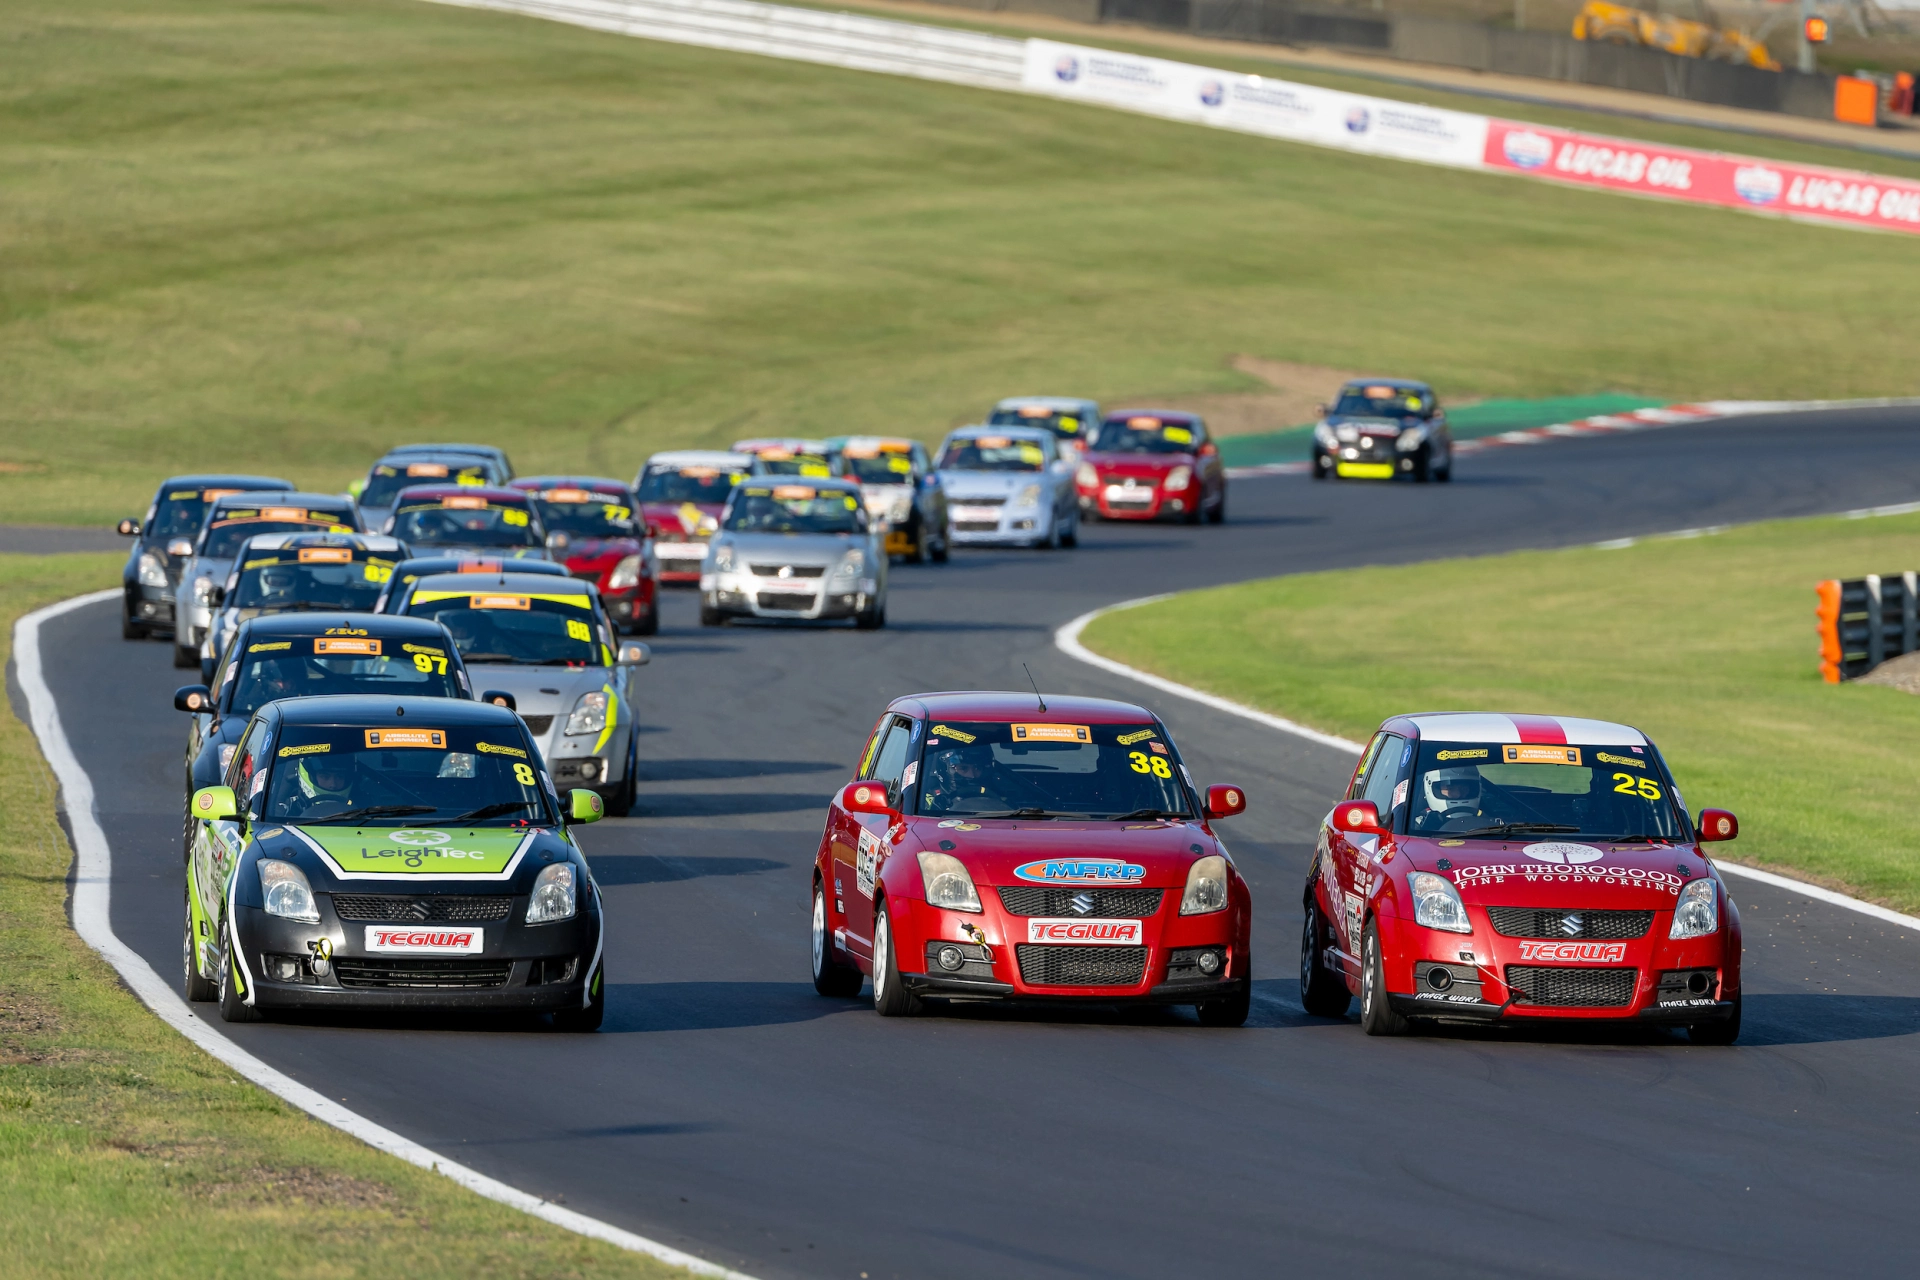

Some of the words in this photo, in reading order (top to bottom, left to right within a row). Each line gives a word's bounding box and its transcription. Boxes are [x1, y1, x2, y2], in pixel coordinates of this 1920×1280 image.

[1555, 142, 1648, 183] LUCAS
[1647, 156, 1693, 190] OIL
[1786, 176, 1880, 216] LUCAS
[325, 628, 368, 636] ZEUS
[566, 620, 591, 643] 88
[413, 653, 448, 675] 97
[512, 762, 536, 786] 8
[1128, 751, 1172, 779] 38
[1612, 772, 1662, 800] 25
[362, 846, 485, 868] LeighTec
[1044, 862, 1146, 879] MFRP
[1452, 864, 1516, 885] JOHN
[1520, 864, 1683, 888] THOROGOOD
[1460, 875, 1505, 889] FINE
[1525, 875, 1679, 896] WOODWORKING
[374, 930, 474, 948] TEGIWA
[1032, 923, 1138, 940] TEGIWA
[1519, 941, 1627, 963] TEGIWA
[1415, 992, 1448, 1000] IMAGE
[1448, 994, 1481, 1003] WORX
[1660, 1000, 1689, 1008] IMAGE
